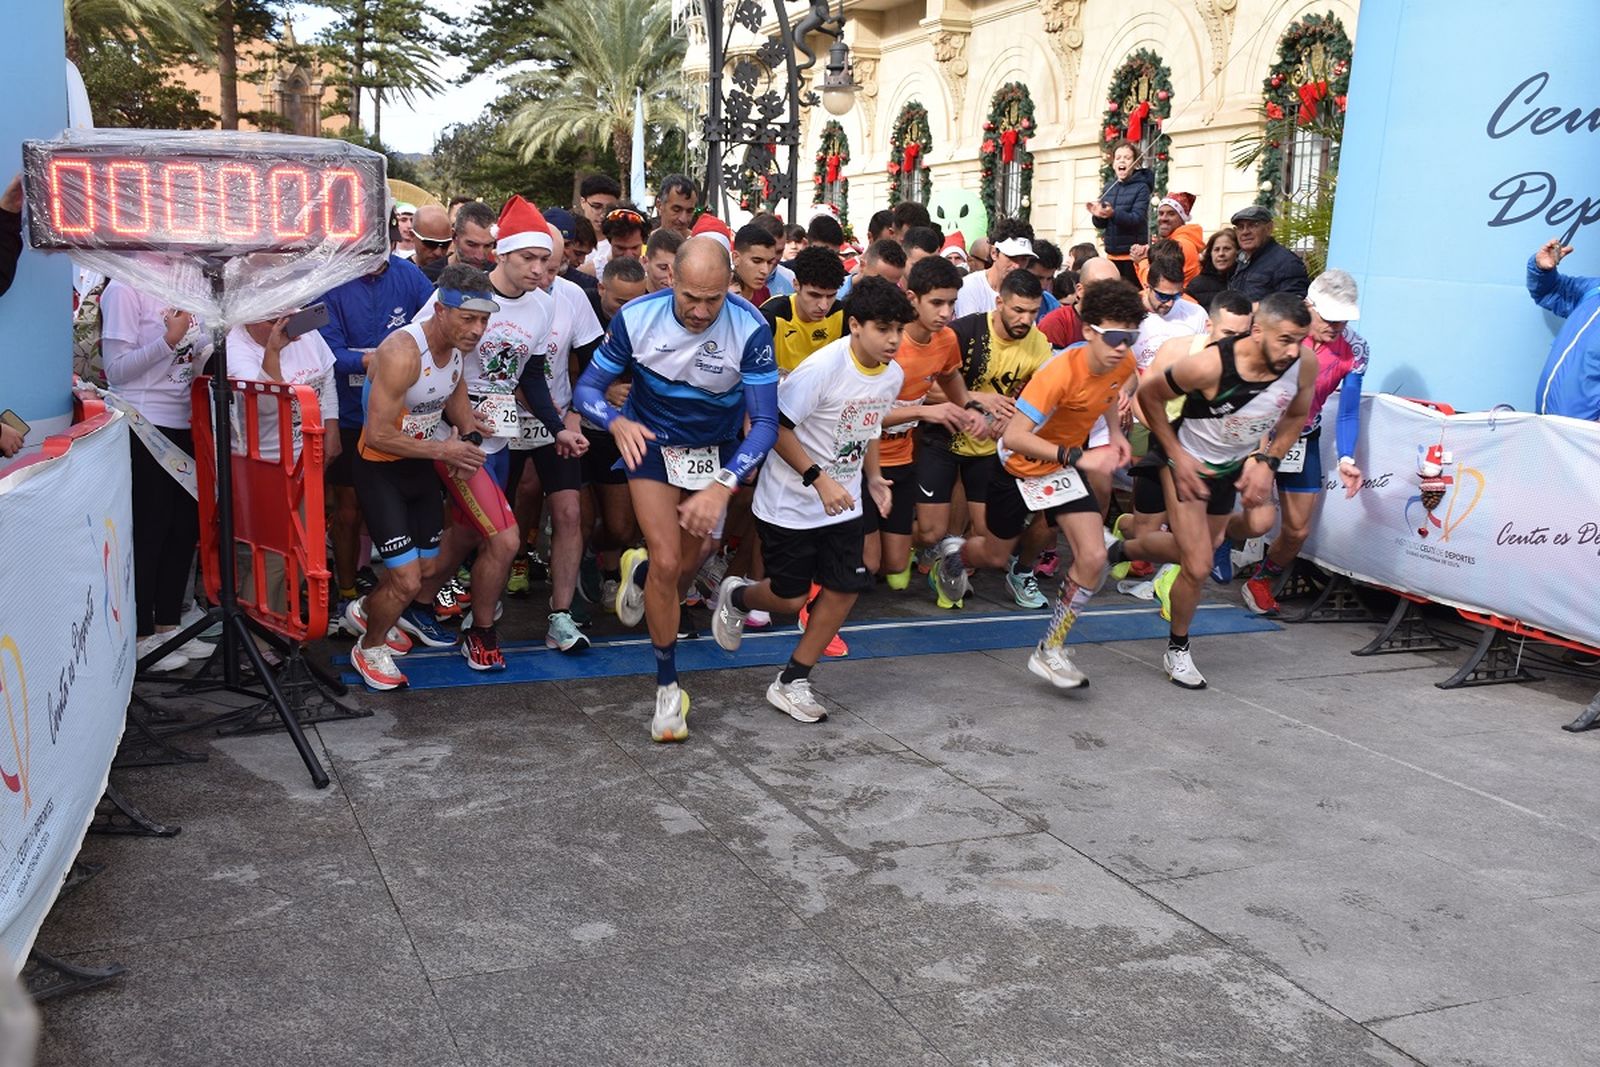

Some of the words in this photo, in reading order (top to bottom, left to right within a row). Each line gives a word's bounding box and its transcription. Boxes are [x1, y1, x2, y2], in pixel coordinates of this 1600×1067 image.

[862, 411, 879, 427] 80
[522, 425, 549, 440] 270
[686, 458, 715, 475] 268
[1051, 476, 1072, 492] 20
[1496, 521, 1550, 546] Ceuta
[1552, 532, 1571, 546] es
[1445, 550, 1475, 565] DEPORTES
